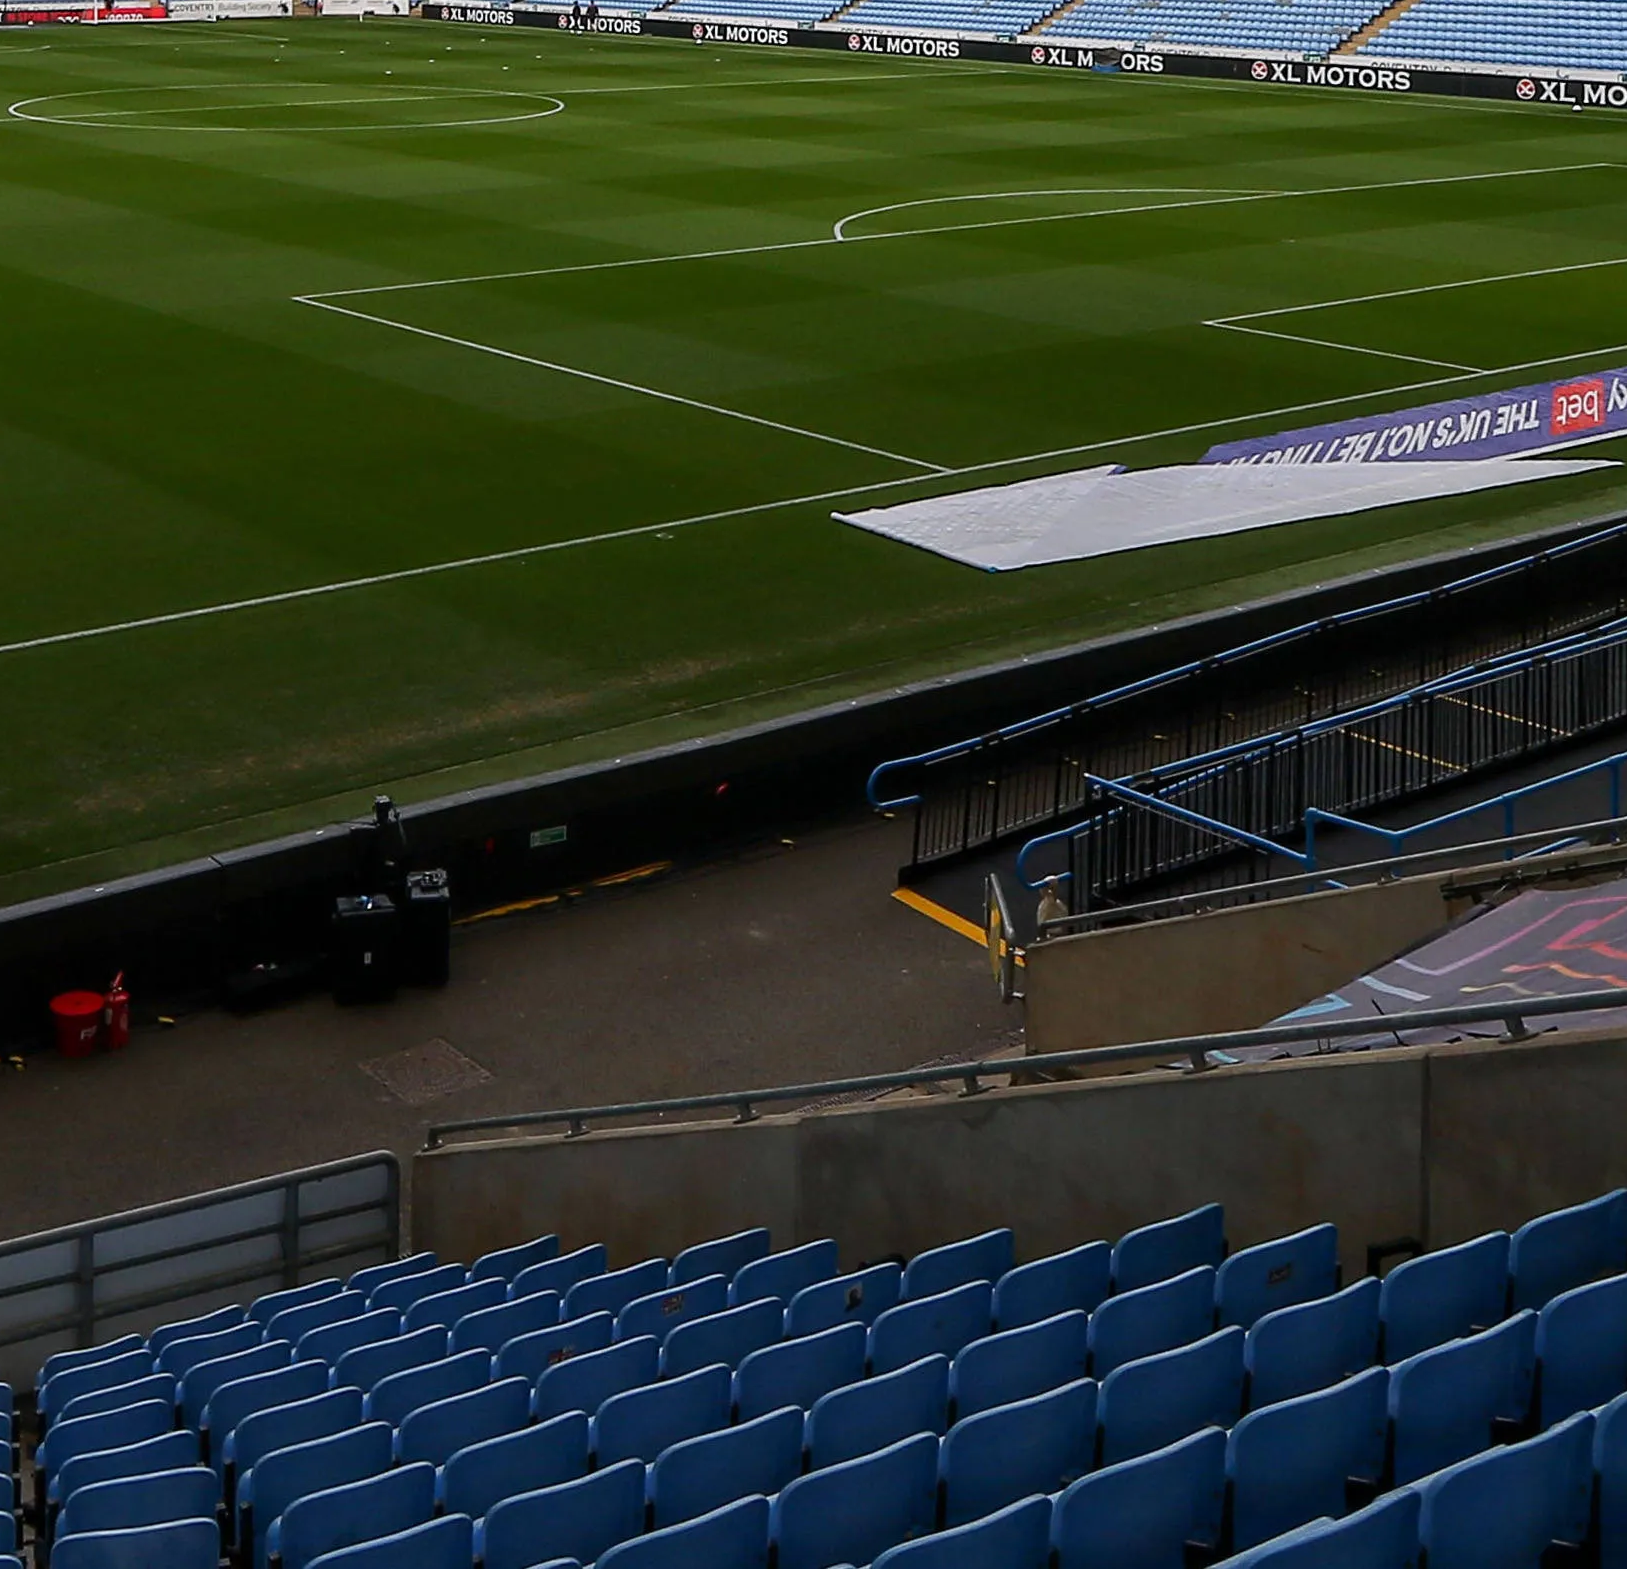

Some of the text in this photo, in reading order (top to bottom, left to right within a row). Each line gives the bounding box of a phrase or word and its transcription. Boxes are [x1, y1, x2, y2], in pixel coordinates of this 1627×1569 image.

[450, 8, 514, 24] XL MOTORS
[705, 25, 788, 44] XL MOTORS
[862, 35, 960, 57] XL MOTORS
[1047, 48, 1164, 72] XL MORS
[1270, 62, 1411, 90] XL MOTORS
[1539, 80, 1576, 103] XL
[1495, 398, 1540, 438] THE
[1555, 388, 1600, 426] bet
[1433, 407, 1491, 449] UK'S
